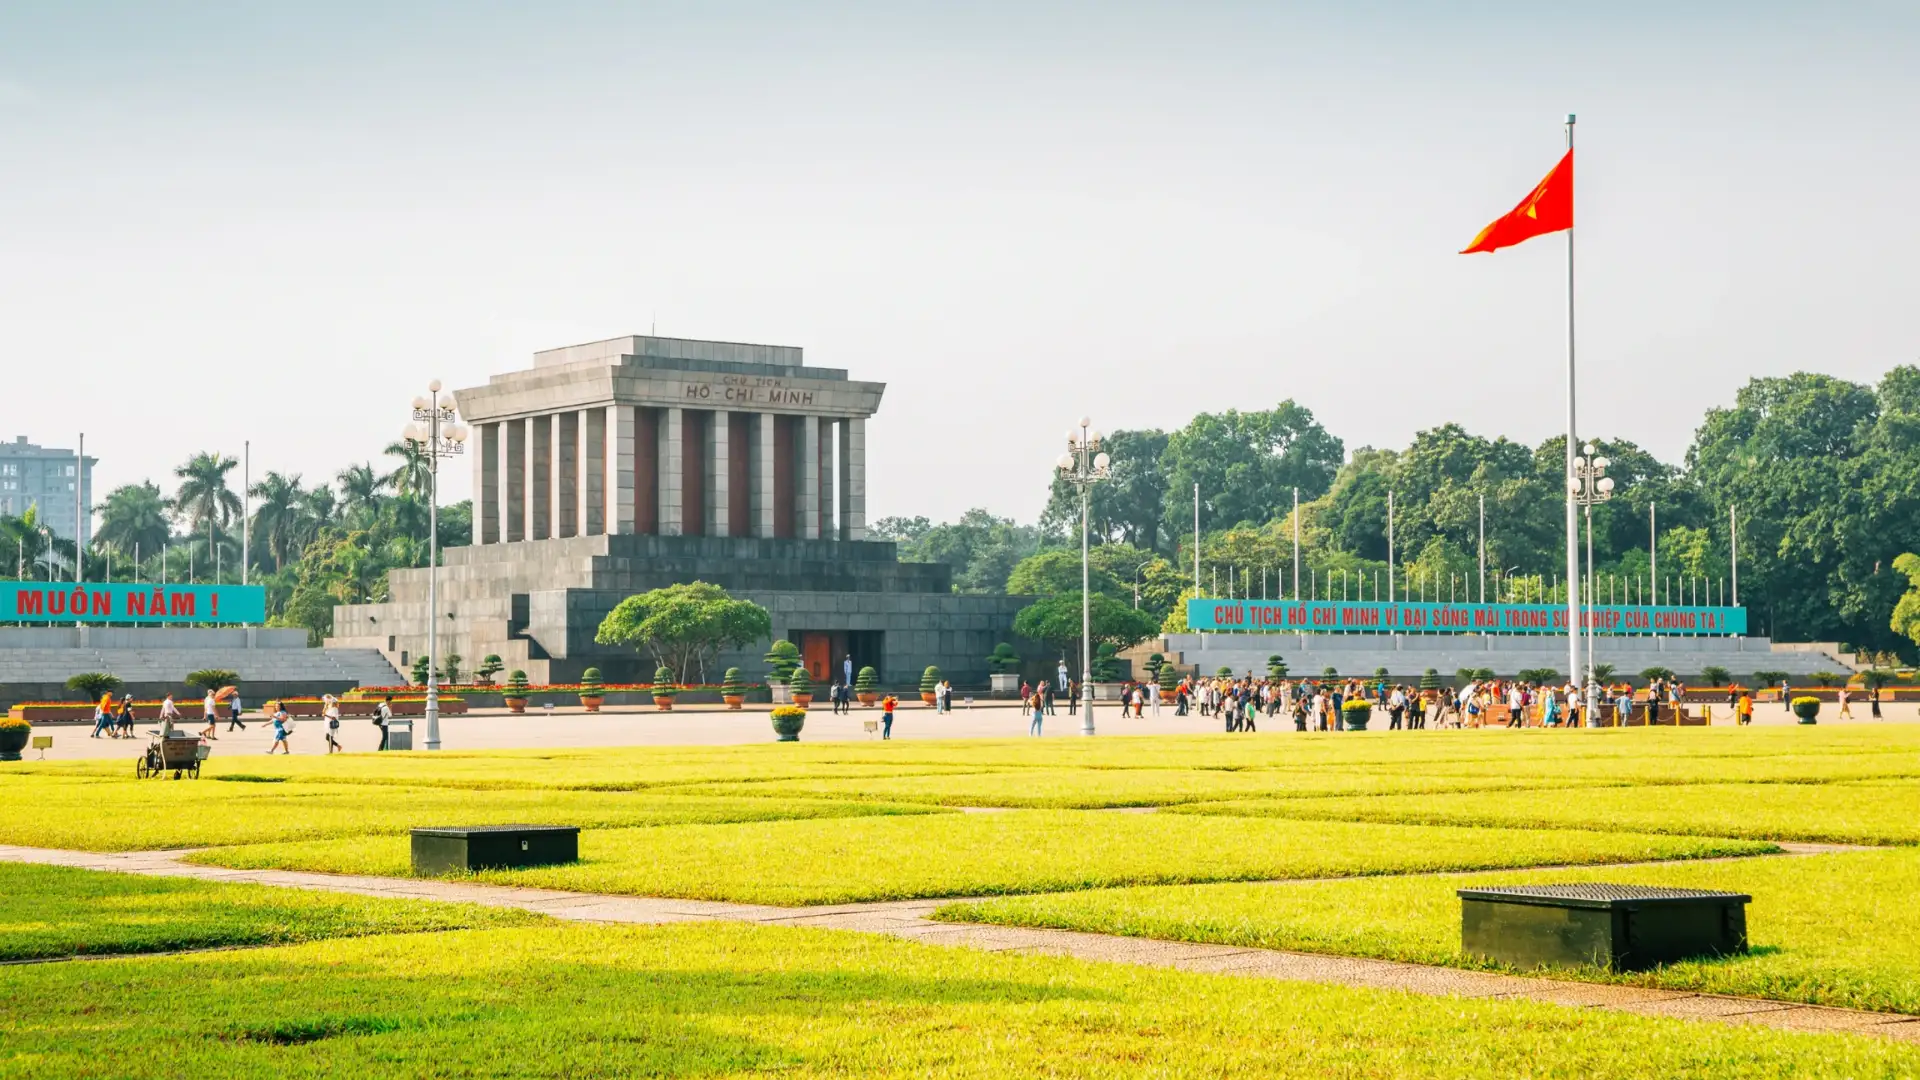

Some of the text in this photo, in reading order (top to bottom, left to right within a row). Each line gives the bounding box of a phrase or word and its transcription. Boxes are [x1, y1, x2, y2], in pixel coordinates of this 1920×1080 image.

[17, 586, 111, 615] MUÔN
[127, 587, 195, 616] NĂM
[1214, 600, 1243, 625] CHỦ
[1249, 606, 1282, 628] TỊCH
[1312, 603, 1336, 625] CHÍ
[1342, 607, 1378, 625] MINH
[1404, 608, 1426, 630] ĐẠI
[1432, 604, 1469, 626] SỐNG
[1504, 609, 1547, 627] TRONG
[1625, 606, 1650, 628] CỦA
[1655, 608, 1696, 629] CHÚNG
[1701, 612, 1716, 628] TA
